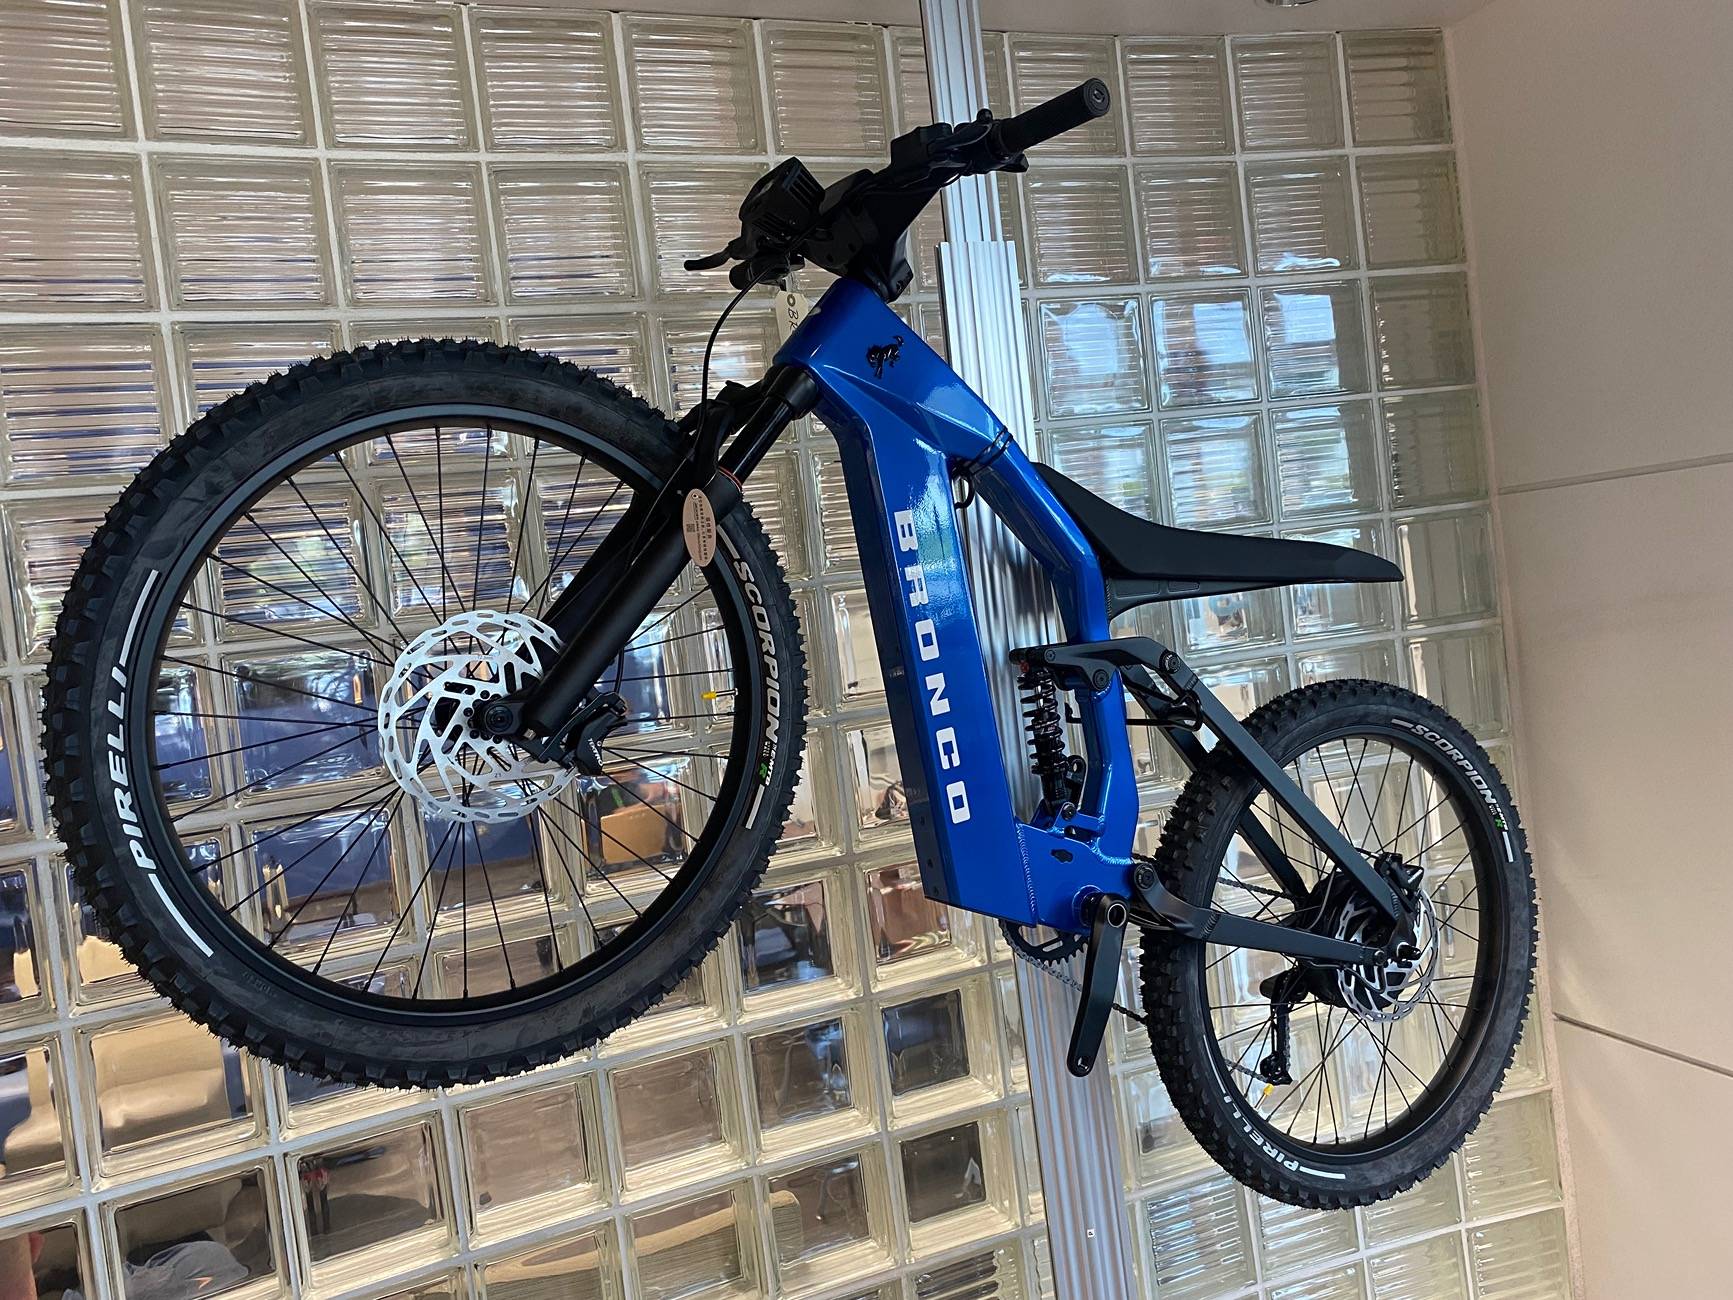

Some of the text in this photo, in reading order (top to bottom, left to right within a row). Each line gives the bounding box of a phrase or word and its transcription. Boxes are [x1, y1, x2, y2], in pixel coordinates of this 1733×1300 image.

[733, 560, 780, 744] SCORPION
[894, 509, 971, 825] BRONCO
[107, 664, 158, 872] PIRELLI
[587, 737, 604, 768] TEKTRO
[1411, 724, 1497, 804] SCORPION
[1223, 1095, 1300, 1172] PIRELLI
